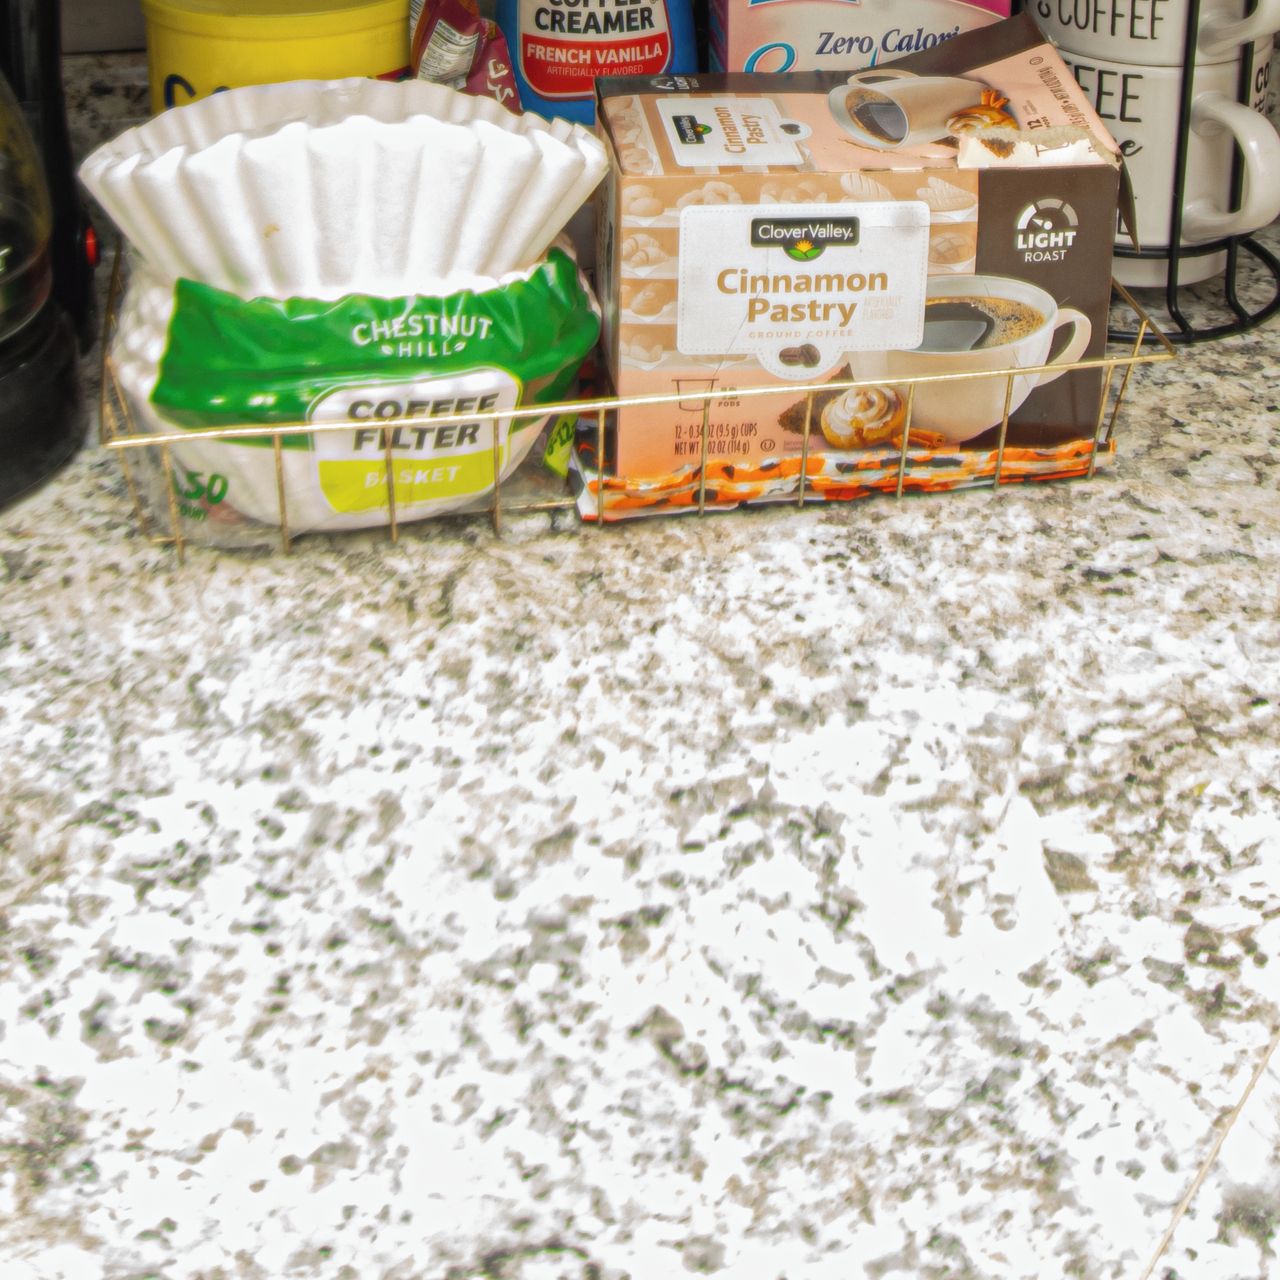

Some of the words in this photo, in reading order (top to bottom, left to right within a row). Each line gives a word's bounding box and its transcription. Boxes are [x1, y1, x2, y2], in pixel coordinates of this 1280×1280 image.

[534, 7, 655, 34] CREAMER
[527, 43, 591, 64] FRENCH
[595, 42, 663, 64] VANILLA
[816, 31, 874, 55] Zero
[547, 65, 601, 77] ARTIFICIALLY
[602, 64, 644, 77] FLAVORED
[714, 106, 747, 154] Cinnamon
[741, 114, 768, 144] Pastry
[1017, 231, 1077, 250] LIGHT
[1024, 250, 1068, 262] ROAST
[717, 269, 889, 295] Cinnamon
[748, 297, 858, 328] Pastry
[352, 316, 493, 347] CHESTNUT
[748, 330, 801, 339] GROUND
[806, 329, 854, 339] COFFEE
[399, 342, 451, 358] HILL
[348, 393, 500, 419] COFFEE
[718, 400, 741, 408] PODS
[353, 423, 481, 451] FILTER
[675, 425, 682, 439] 12
[716, 423, 730, 439] (9.5
[741, 422, 758, 437] CUPS
[675, 441, 688, 455] NET
[689, 440, 700, 454] WT
[717, 440, 726, 453] OZ
[727, 439, 741, 454] (114
